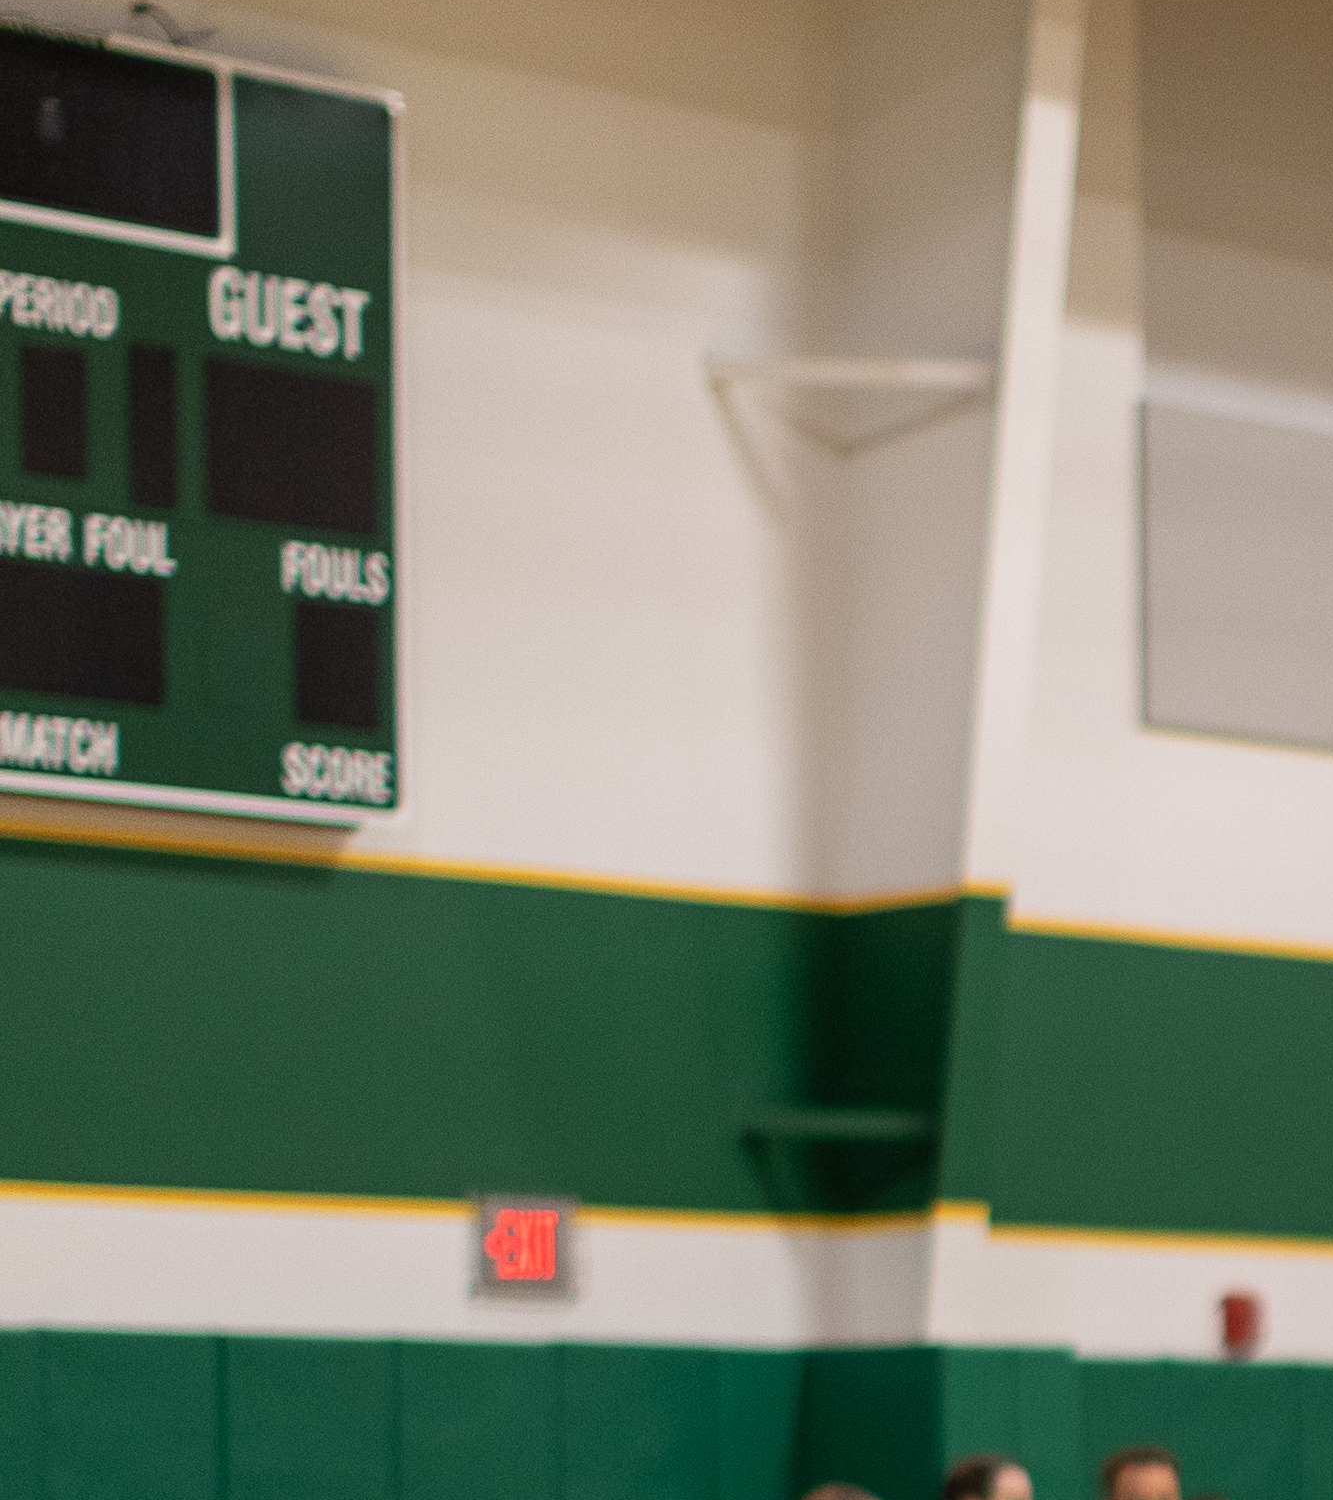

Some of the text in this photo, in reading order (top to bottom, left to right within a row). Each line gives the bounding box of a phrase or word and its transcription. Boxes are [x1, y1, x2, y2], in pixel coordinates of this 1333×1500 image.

[209, 266, 370, 358] GUEST
[83, 512, 178, 578] FOUL
[281, 540, 391, 605] FOULS
[282, 741, 393, 804] SCORE
